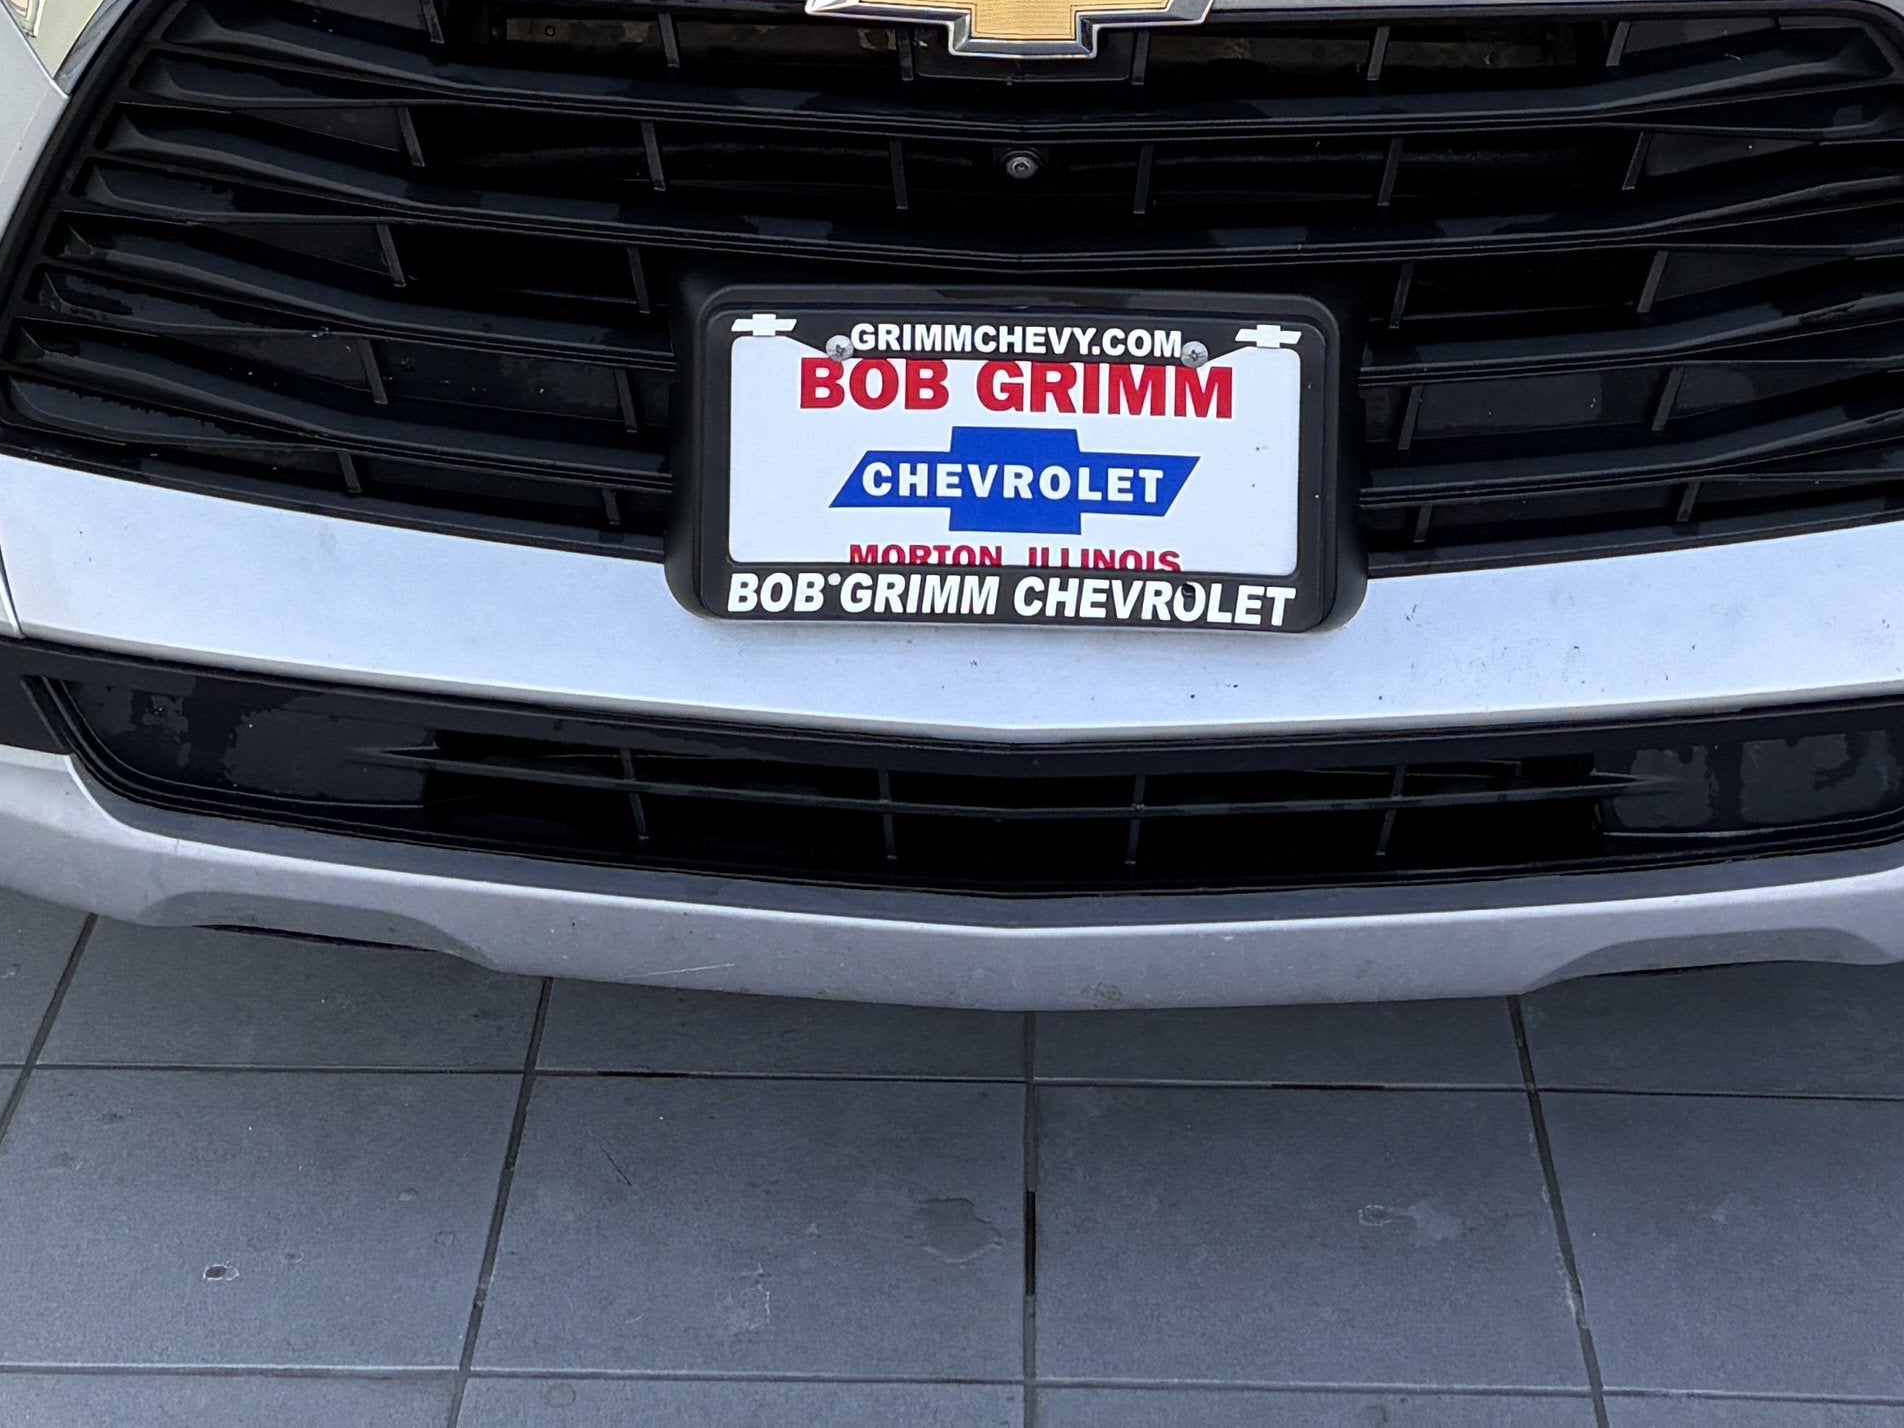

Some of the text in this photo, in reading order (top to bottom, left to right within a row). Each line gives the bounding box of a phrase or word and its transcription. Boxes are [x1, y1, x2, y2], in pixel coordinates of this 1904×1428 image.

[850, 322, 1182, 358] GRIMMCHEVY.COM
[799, 357, 1234, 420] BOB GRIMM
[861, 461, 1165, 504] CHEVROLET
[848, 543, 1183, 574] MORTON ILLINOIS
[726, 571, 1297, 628] BOB GRIMM CHEVROLET
